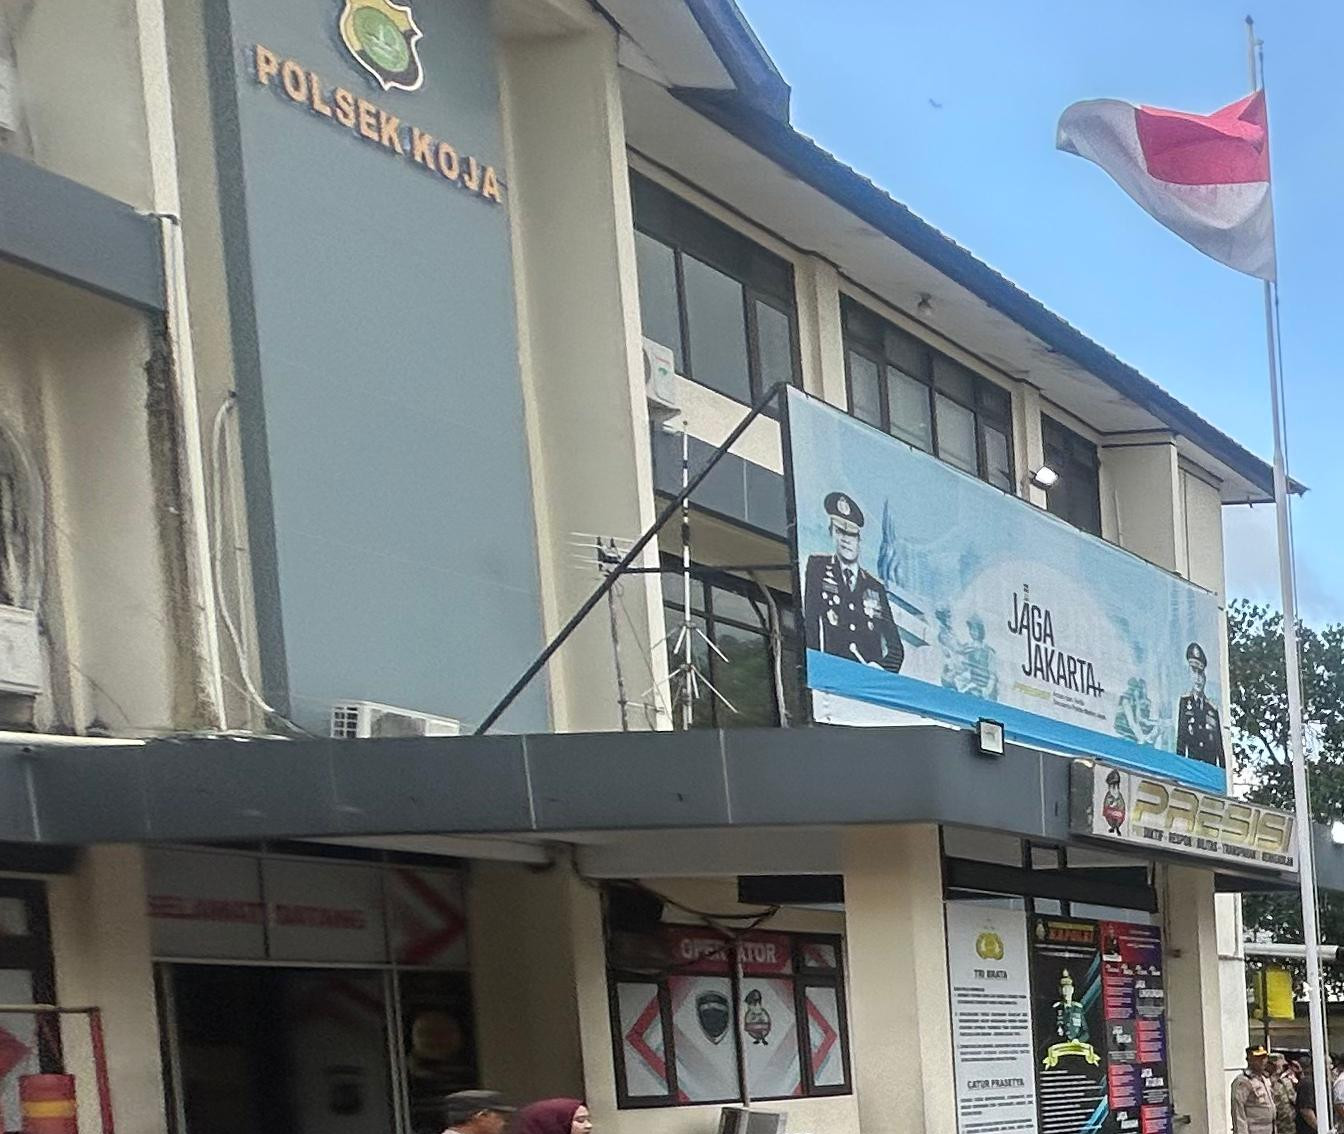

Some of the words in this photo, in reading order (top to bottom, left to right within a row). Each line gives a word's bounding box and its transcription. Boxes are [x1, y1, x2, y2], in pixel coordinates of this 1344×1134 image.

[254, 43, 404, 155] POLSEK
[410, 126, 502, 203] KOJA
[1008, 592, 1055, 647] JAGA
[1131, 779, 1293, 853] PRESISI
